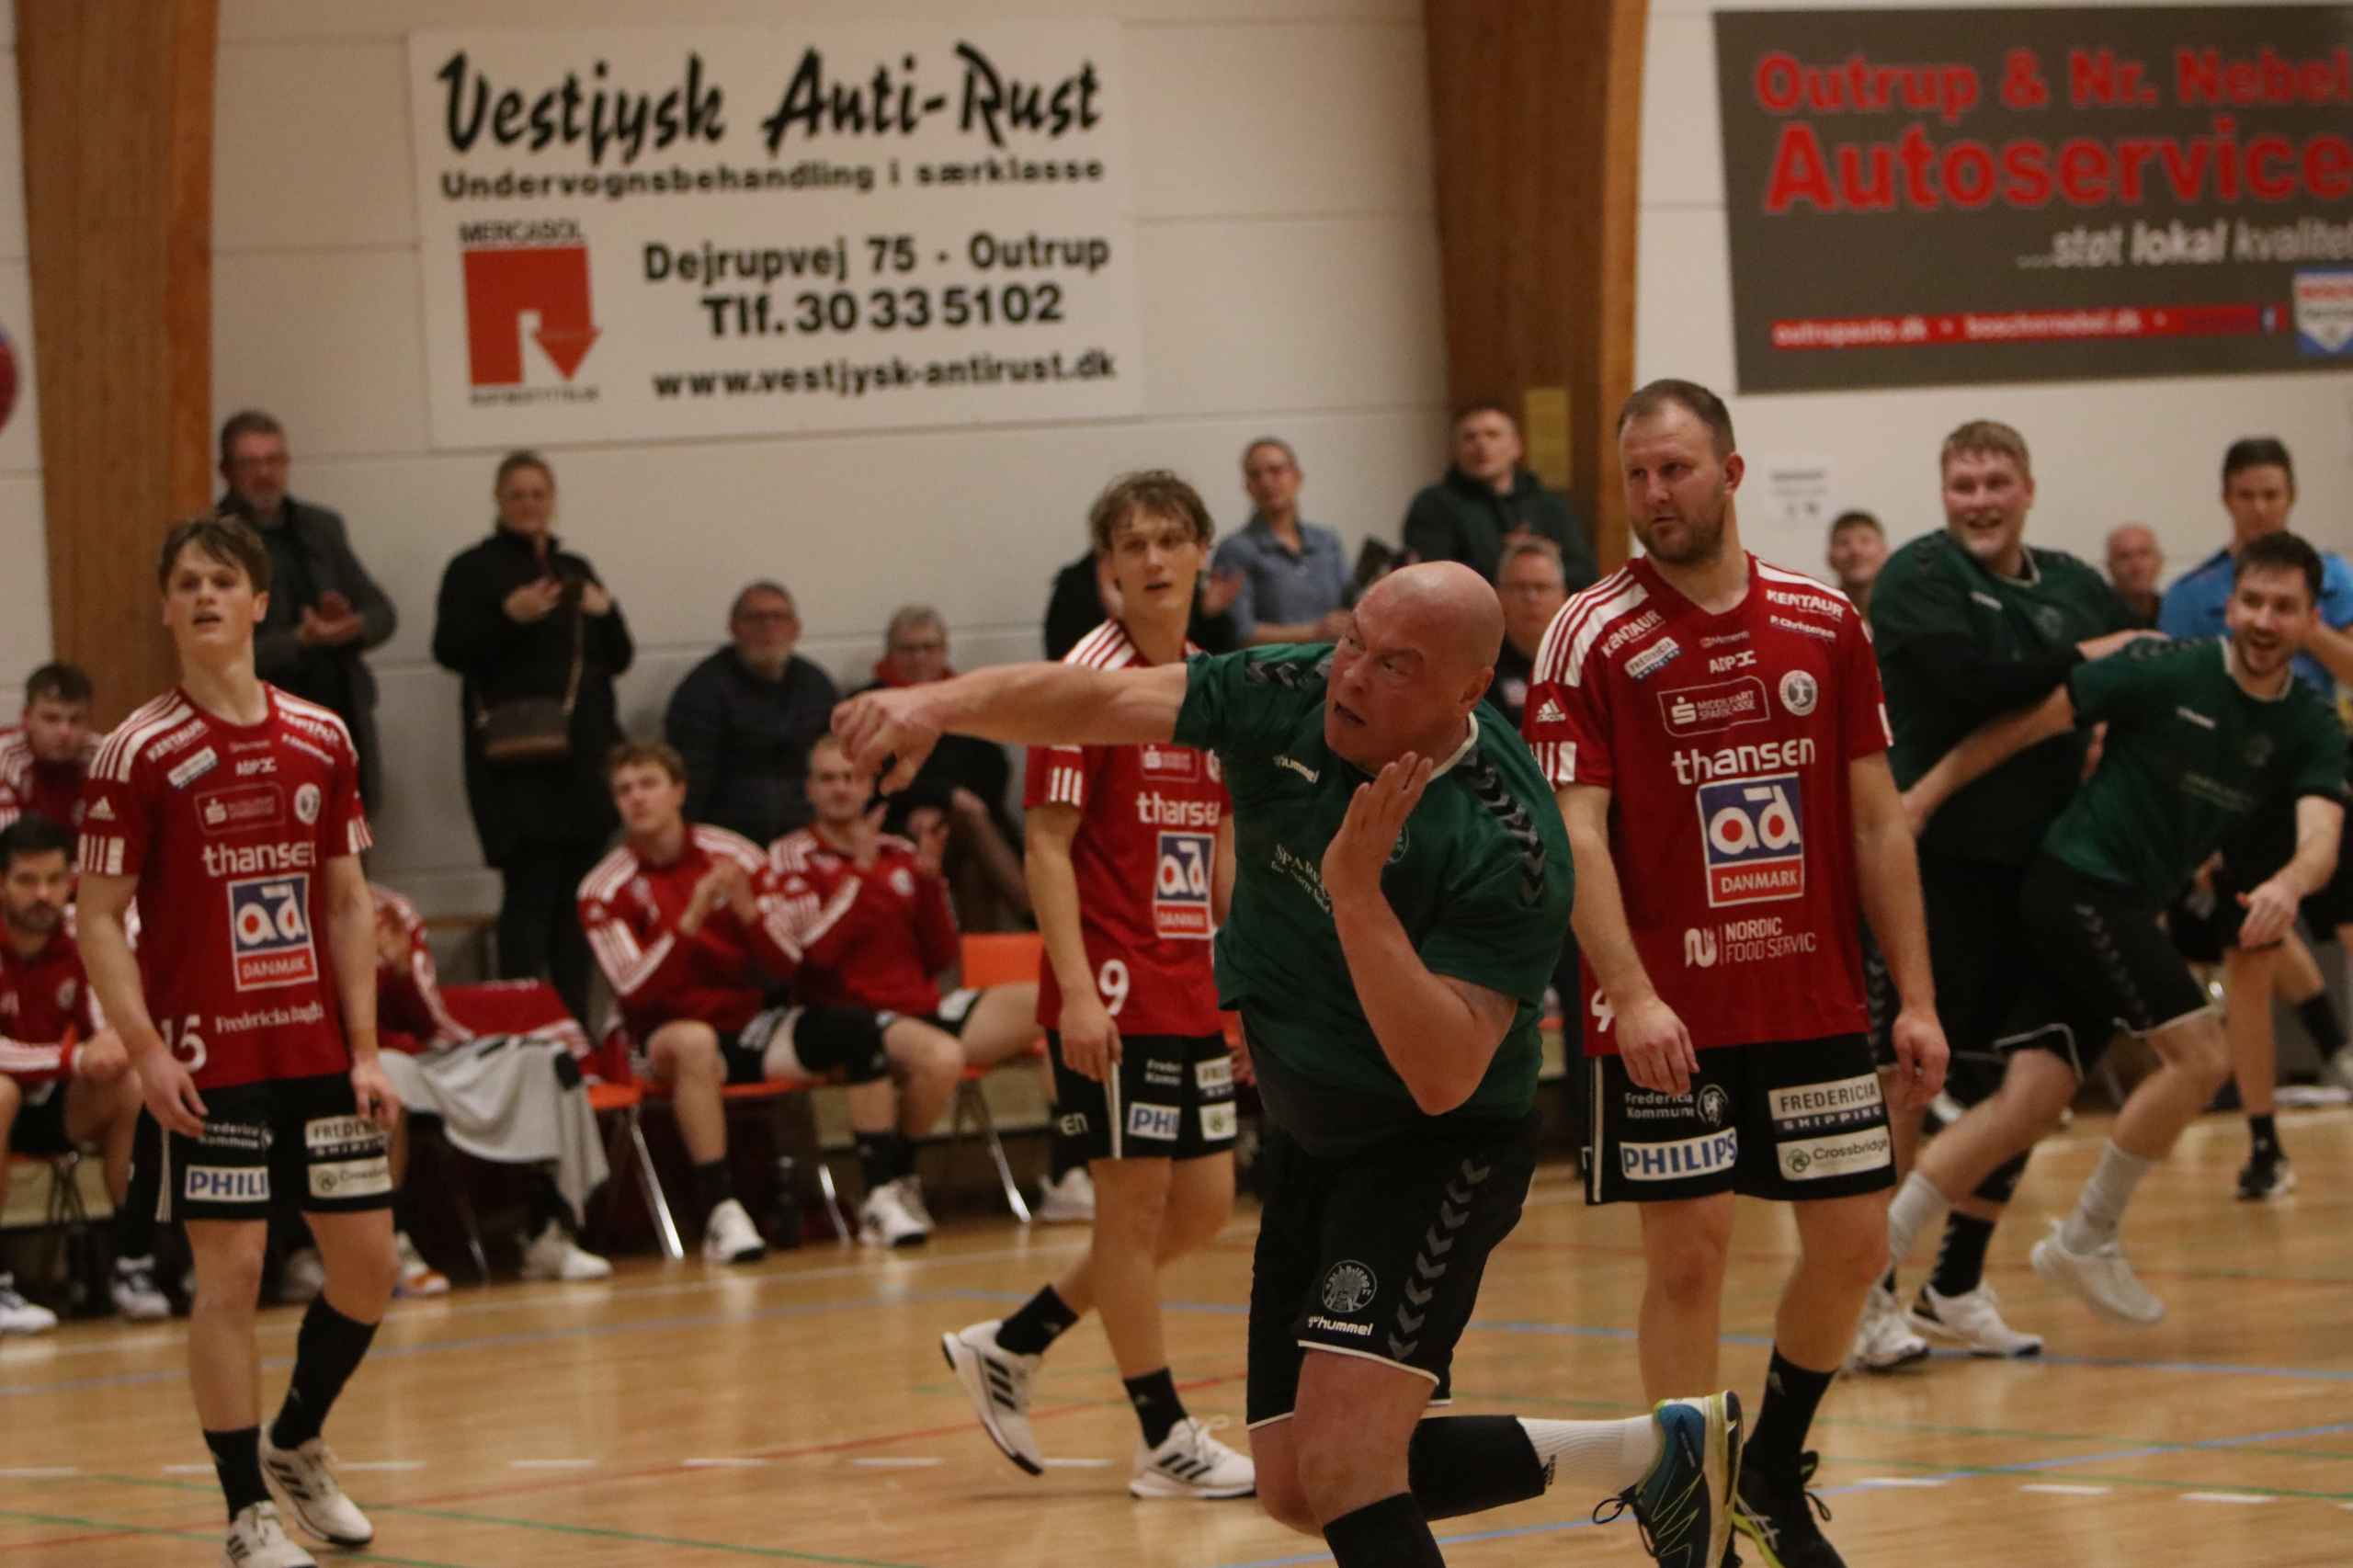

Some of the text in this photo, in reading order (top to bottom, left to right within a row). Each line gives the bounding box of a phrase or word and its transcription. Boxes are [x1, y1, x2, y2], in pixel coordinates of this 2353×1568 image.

[436, 42, 1102, 165] Vestjysk Anti-Rust
[1755, 46, 2352, 124] Outrup & Nr. Nebel
[441, 156, 1104, 202] Undervognsbehandling i særklasse
[1763, 117, 2353, 213] Autoservice
[643, 237, 849, 287] Dejrupvej
[867, 236, 916, 274] 75
[969, 230, 1109, 272] Outrup
[2130, 219, 2227, 266] lokal
[700, 293, 788, 337] Tlf.
[652, 348, 1118, 401] www.vestjysk-antirust.dk
[1766, 588, 1844, 619] KENTAUR
[1671, 737, 1815, 786] thansen
[1721, 869, 1798, 893] DANMARK
[1725, 917, 1782, 942] NORDIC
[1725, 932, 1816, 964] FOOD SERVIC
[1098, 959, 1130, 1017] 9
[1779, 1083, 1878, 1112] FREDERICIA
[1623, 1133, 1737, 1176] PHILIPS
[1317, 1315, 1374, 1336] hummel
